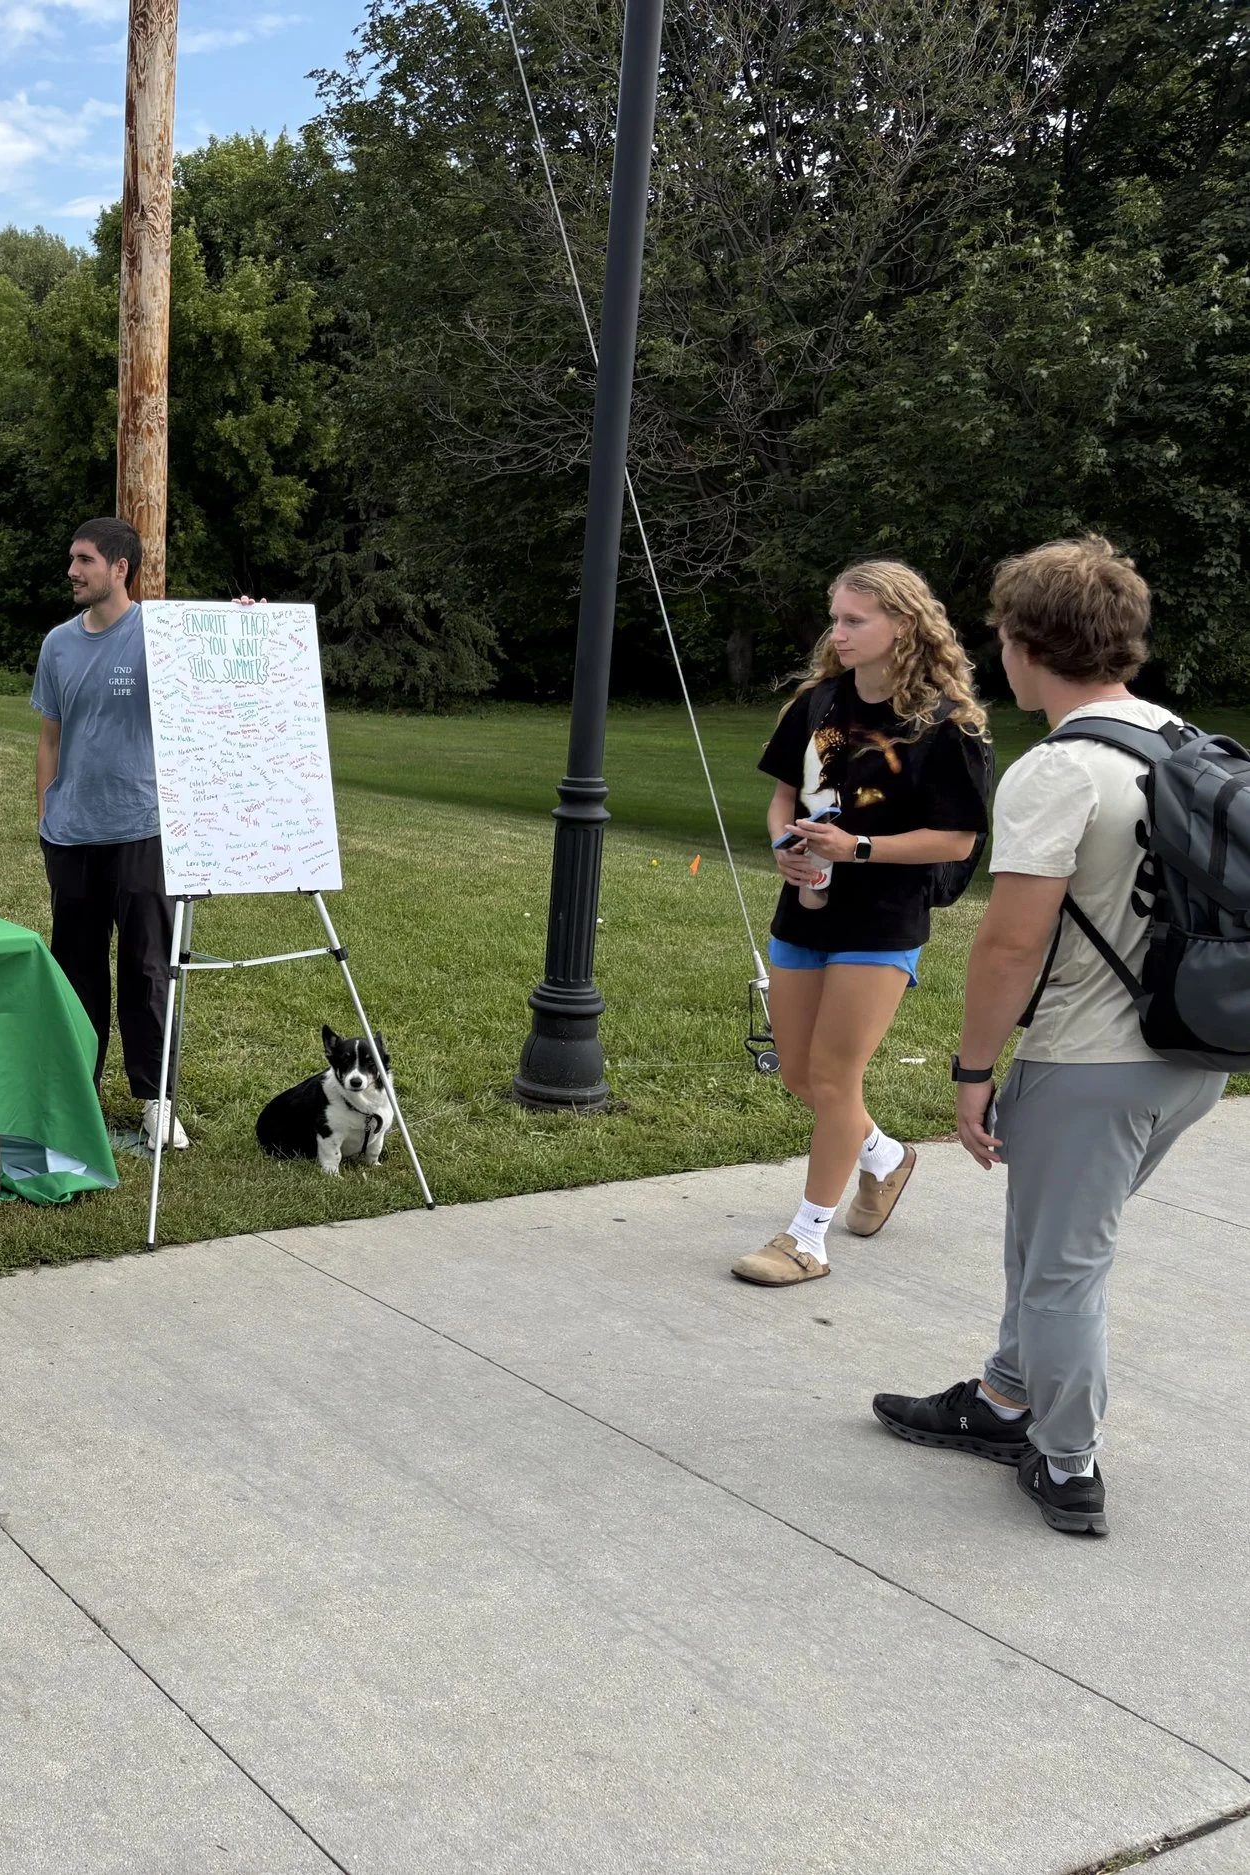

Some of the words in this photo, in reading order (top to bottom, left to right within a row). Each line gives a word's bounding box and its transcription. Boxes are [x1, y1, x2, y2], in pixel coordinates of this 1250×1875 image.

[185, 613, 229, 636] FAVORITE
[240, 614, 267, 637] PLACE
[203, 636, 227, 655] YOU
[232, 638, 259, 658] WENT
[113, 666, 132, 674] UND
[192, 656, 216, 679] THIS
[113, 688, 132, 696] LIFE
